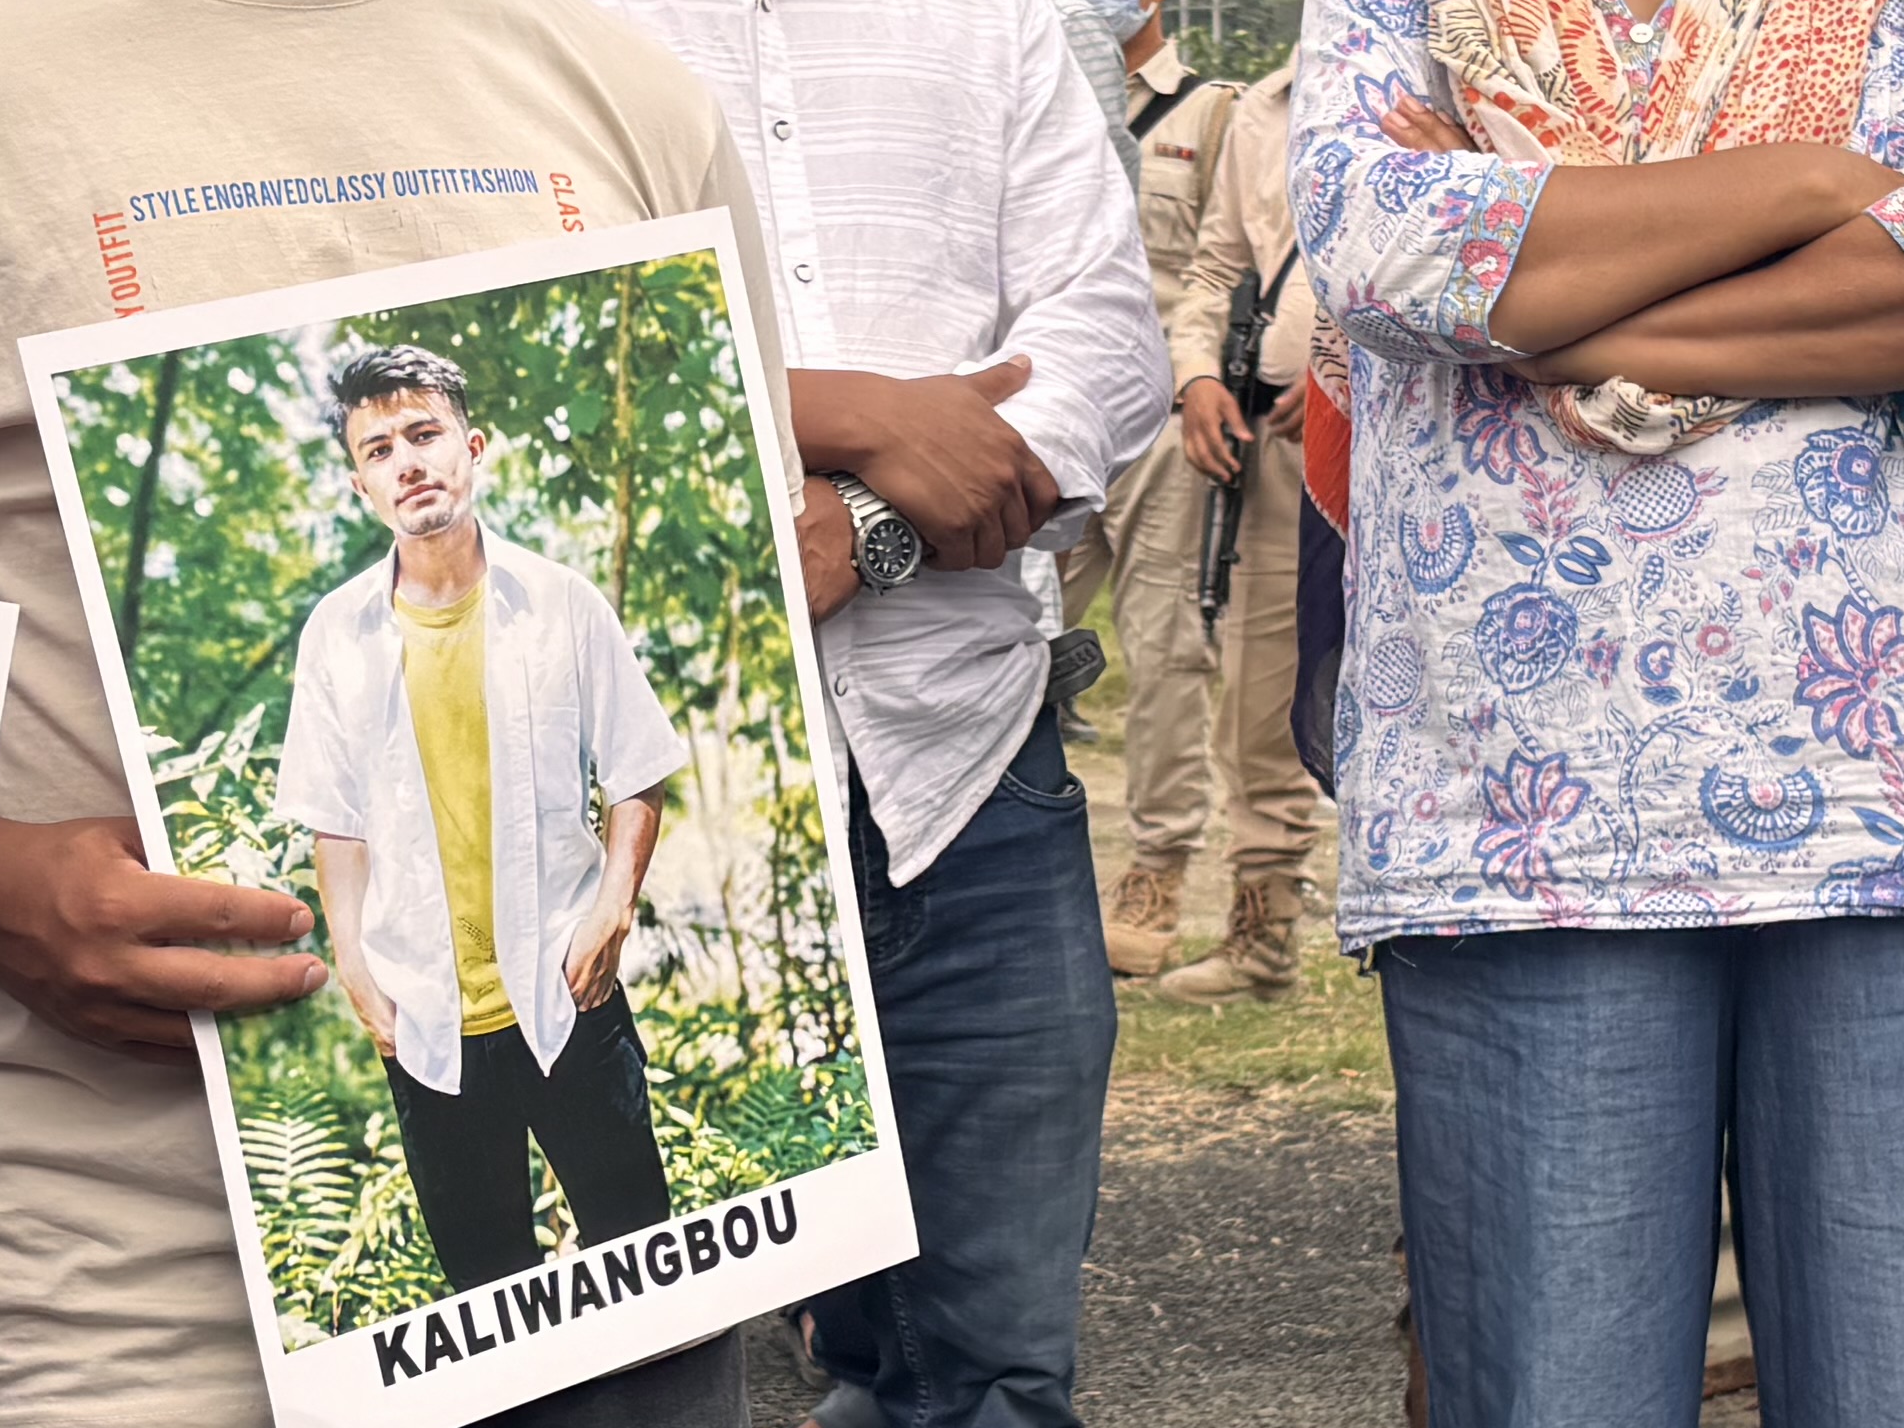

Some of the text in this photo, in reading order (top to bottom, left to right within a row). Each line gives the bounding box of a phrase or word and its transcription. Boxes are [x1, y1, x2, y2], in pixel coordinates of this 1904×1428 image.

[129, 187, 200, 222] STYLE
[392, 169, 459, 197] OUTFIT
[460, 168, 539, 194] FASHION
[92, 212, 141, 301] OUTFIT
[371, 1188, 798, 1387] KALIWANGBOU
